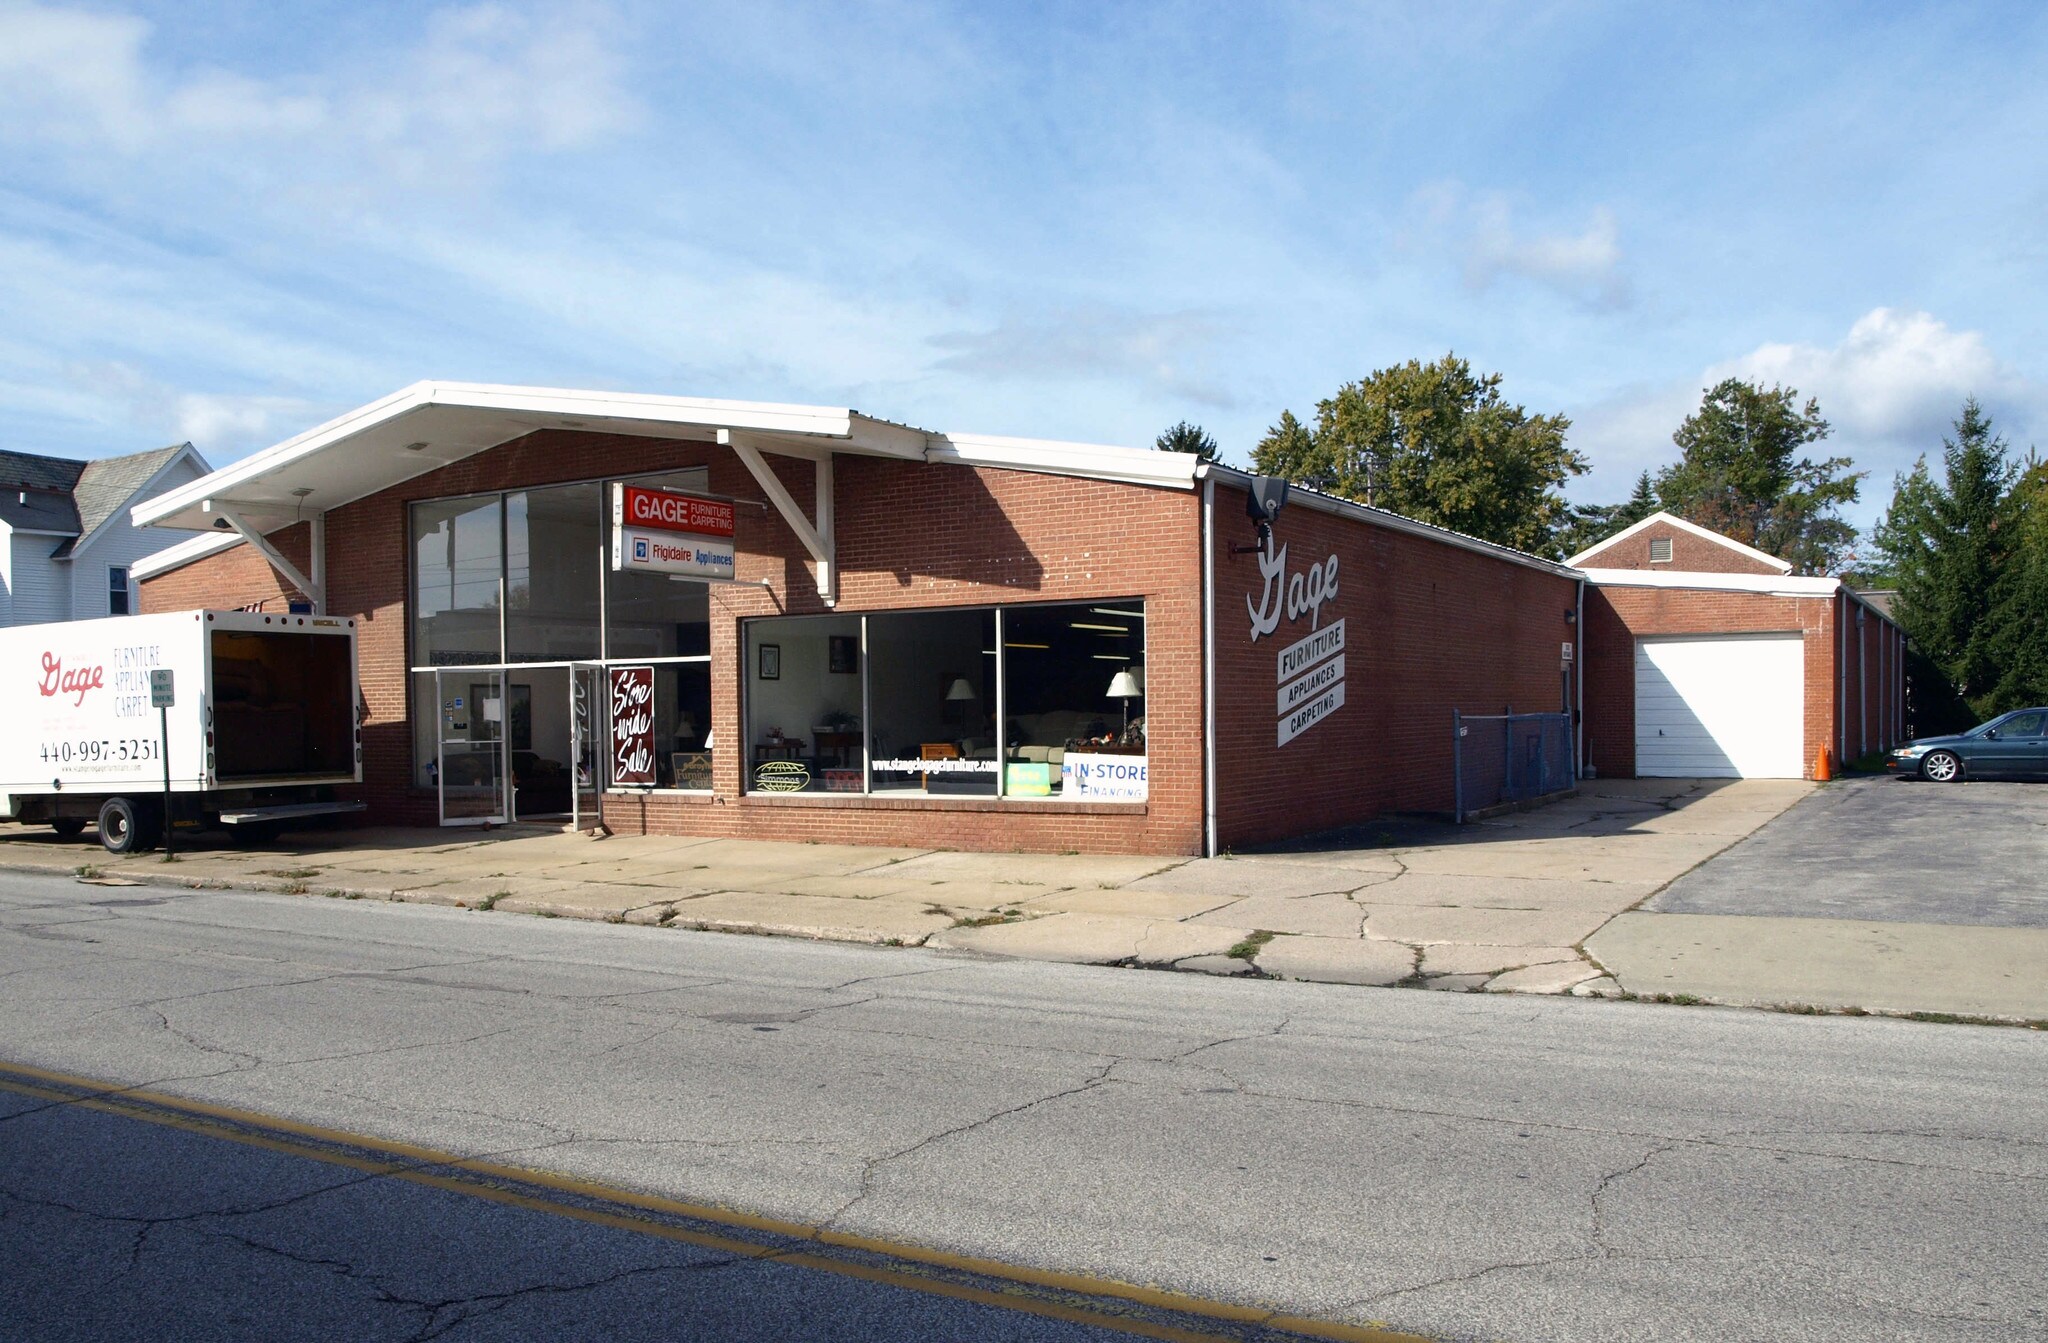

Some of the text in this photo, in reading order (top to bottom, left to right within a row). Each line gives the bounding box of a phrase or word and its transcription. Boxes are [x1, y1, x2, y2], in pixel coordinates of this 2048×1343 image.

[634, 494, 689, 524] GAGE
[690, 503, 732, 519] FURNITURE
[690, 514, 733, 530] CARPETING
[653, 544, 733, 566] Frigidaire Appliances
[1246, 522, 1339, 642] Gage
[114, 645, 160, 668] FURNITURE
[1282, 626, 1341, 675] FURNITURE
[38, 651, 104, 707] Gage
[115, 670, 151, 691] APPLIAN
[1288, 663, 1335, 703] APPLIANCES
[613, 670, 652, 716] Store
[115, 695, 147, 717] CARPET
[1290, 693, 1334, 733] CARPETING
[40, 739, 160, 762] 440-997-5231
[616, 736, 653, 781] Sale
[677, 768, 713, 781] Furnitur
[760, 773, 800, 783] Simmons
[1080, 784, 1142, 797] FINANCING
